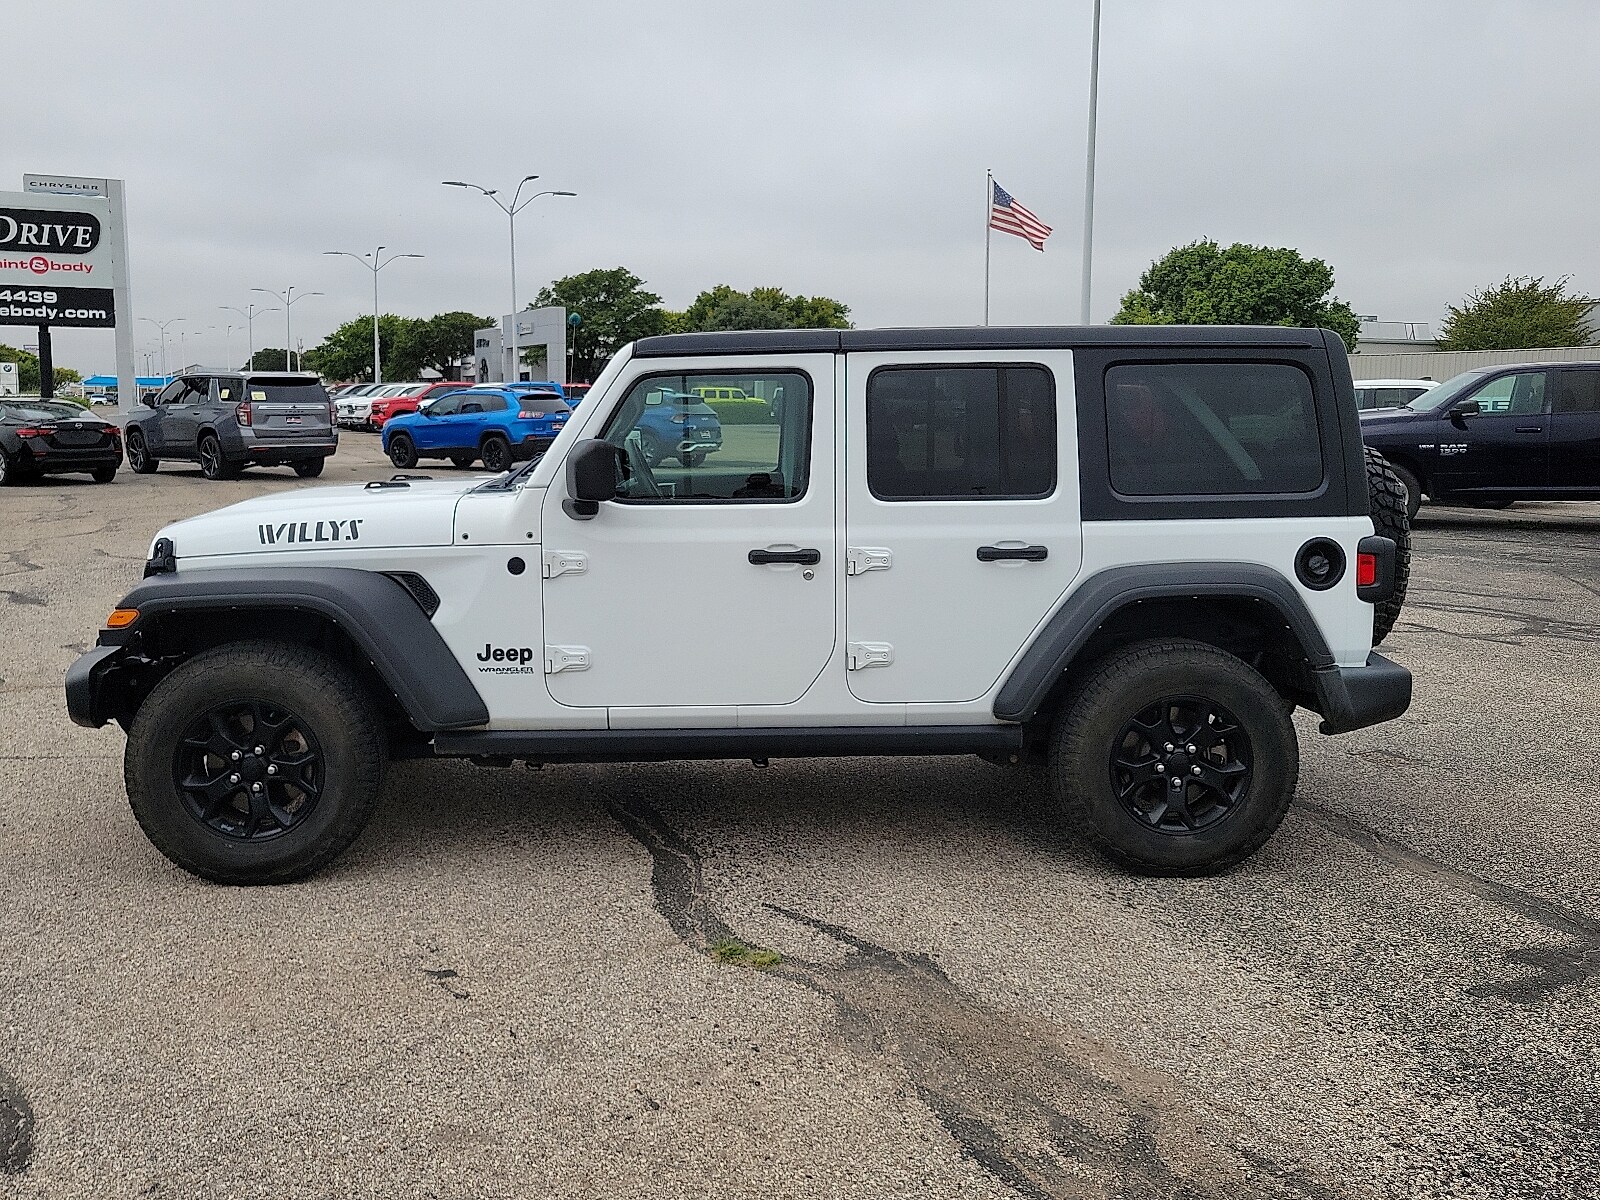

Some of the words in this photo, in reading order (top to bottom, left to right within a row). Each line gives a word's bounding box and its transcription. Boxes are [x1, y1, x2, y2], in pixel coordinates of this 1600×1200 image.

[29, 181, 99, 190] CHRYSLER
[0, 259, 29, 270] int
[51, 261, 93, 273] body
[0, 290, 57, 304] 4439
[0, 304, 106, 319] ebody.com
[258, 519, 363, 545] WILLYS
[476, 643, 533, 665] Jeep
